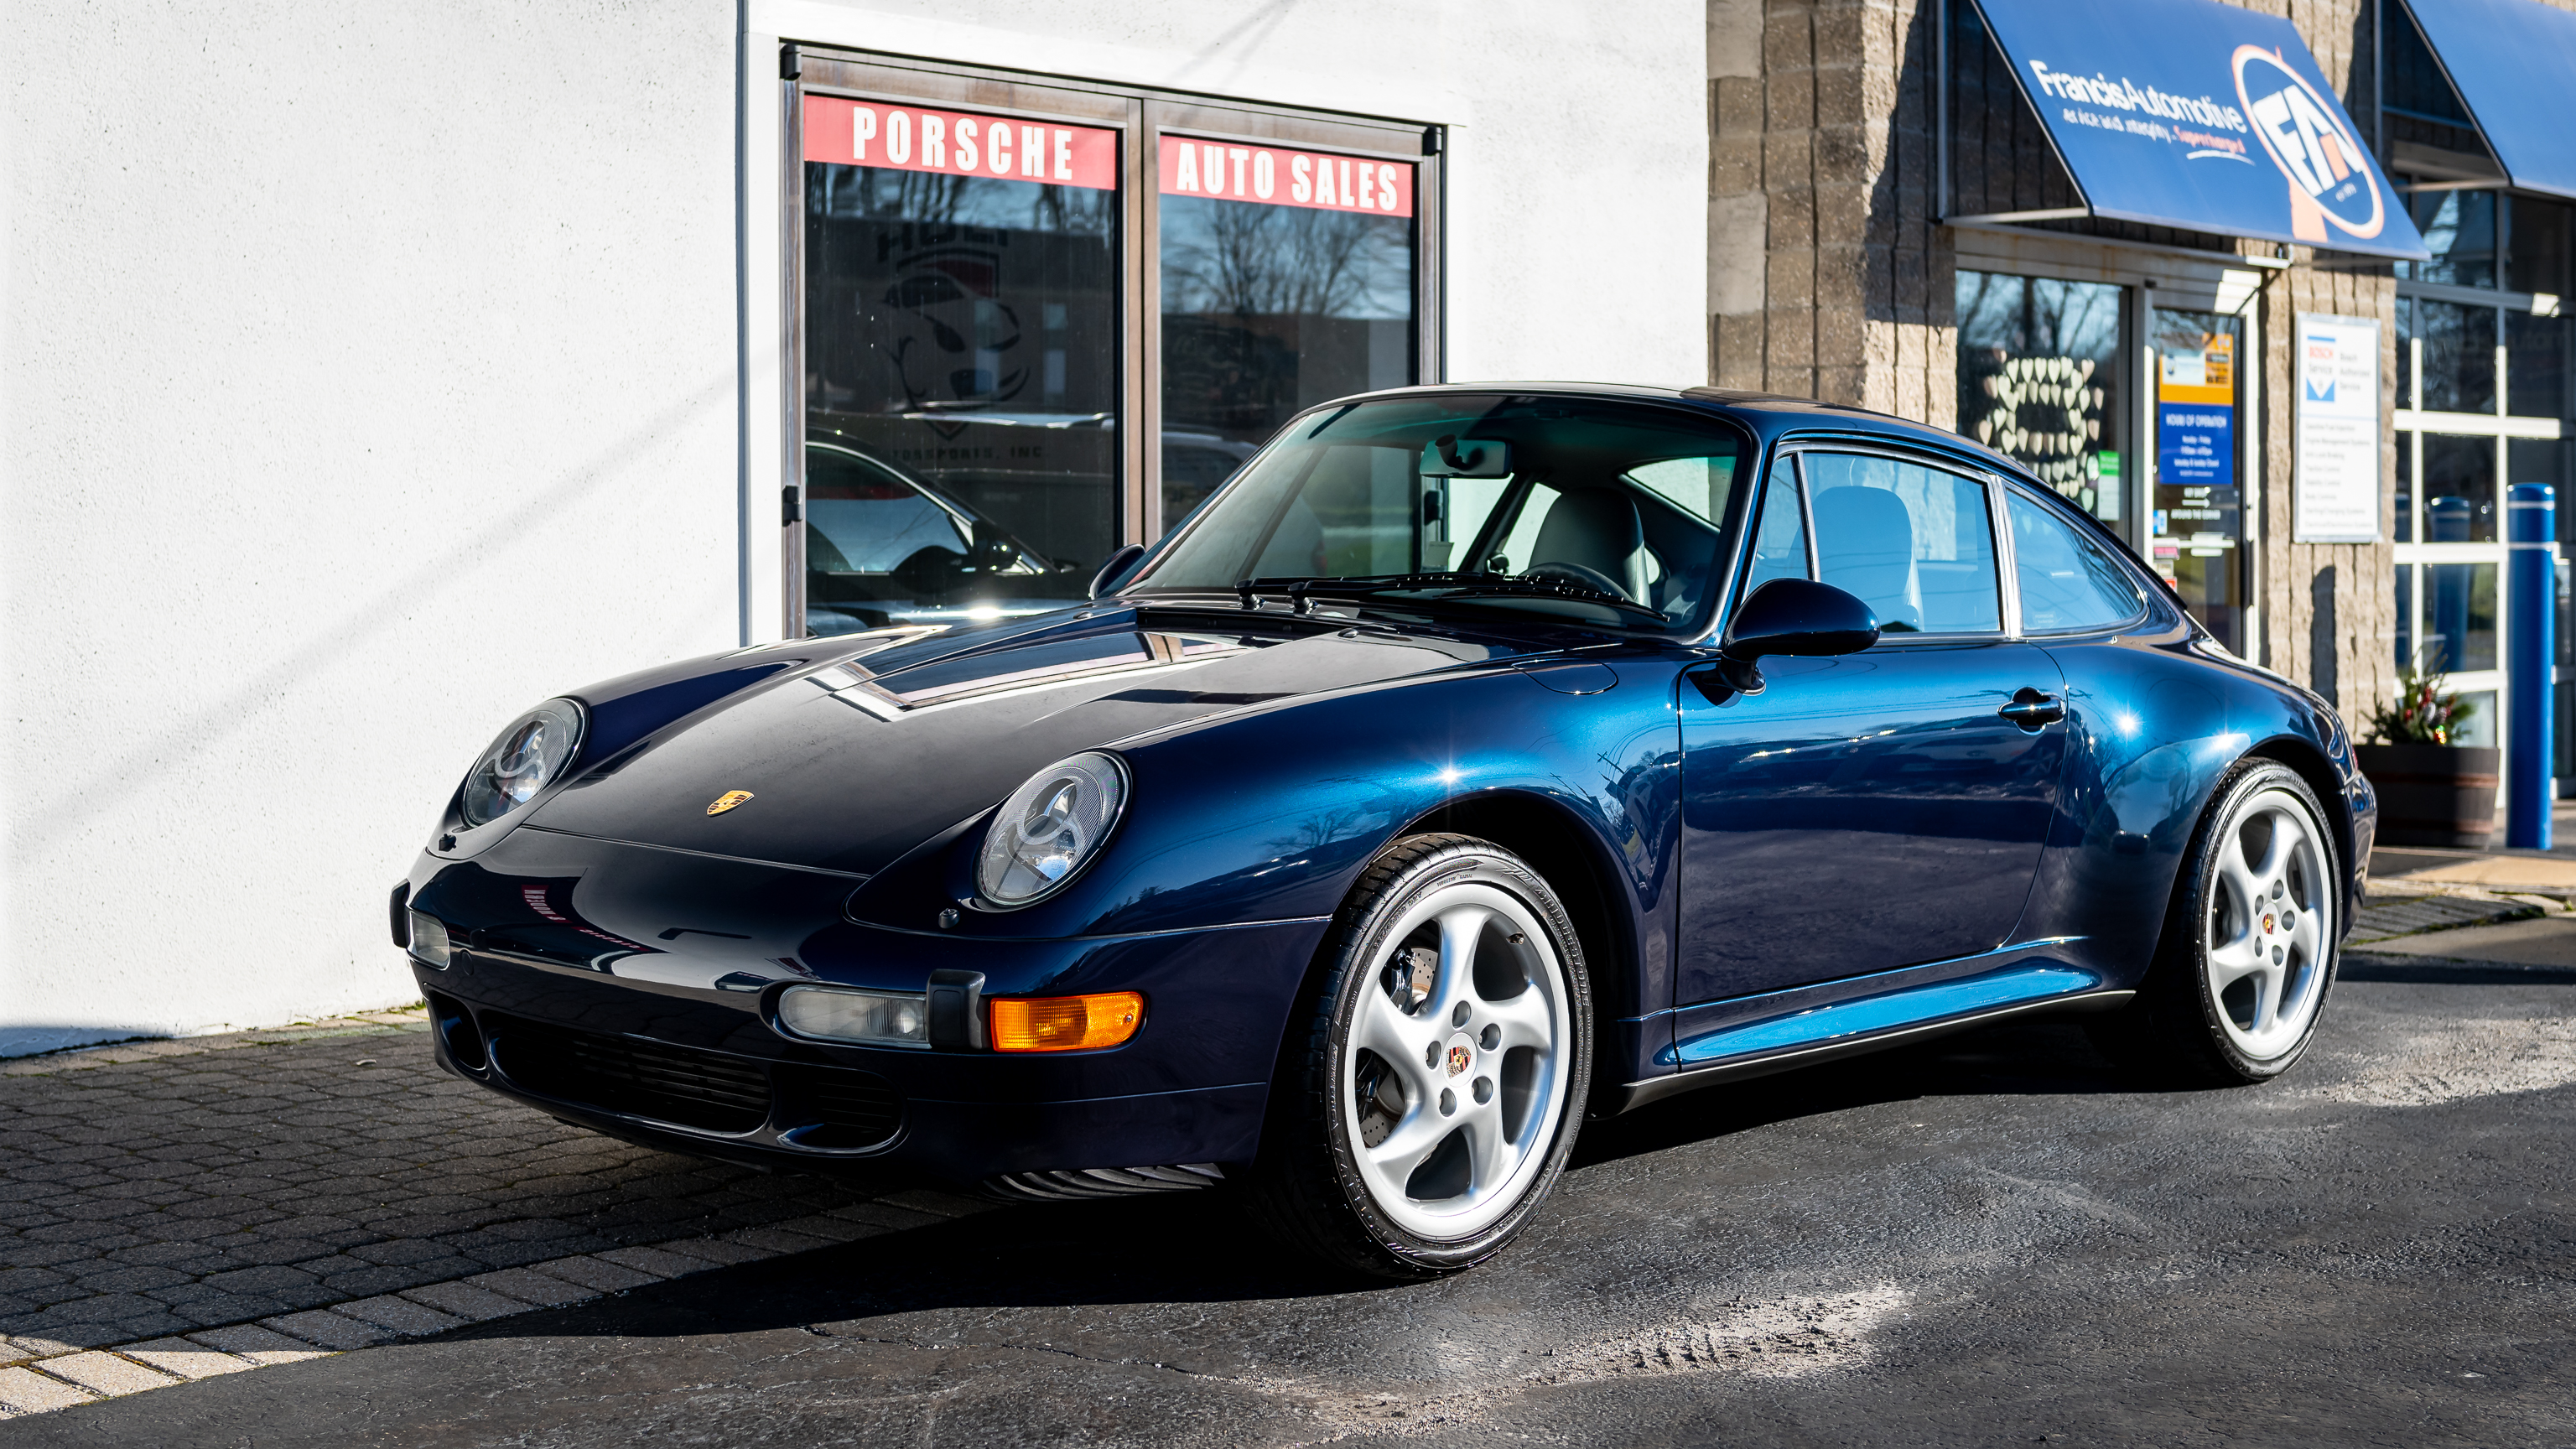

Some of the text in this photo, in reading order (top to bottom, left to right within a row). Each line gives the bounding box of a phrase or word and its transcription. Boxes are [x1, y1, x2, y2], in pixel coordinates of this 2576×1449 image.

[853, 106, 1072, 180] PORSCHE
[1176, 142, 1397, 211] AUTO SALES
[1533, 882, 1591, 1009] BRIDGESTONE
